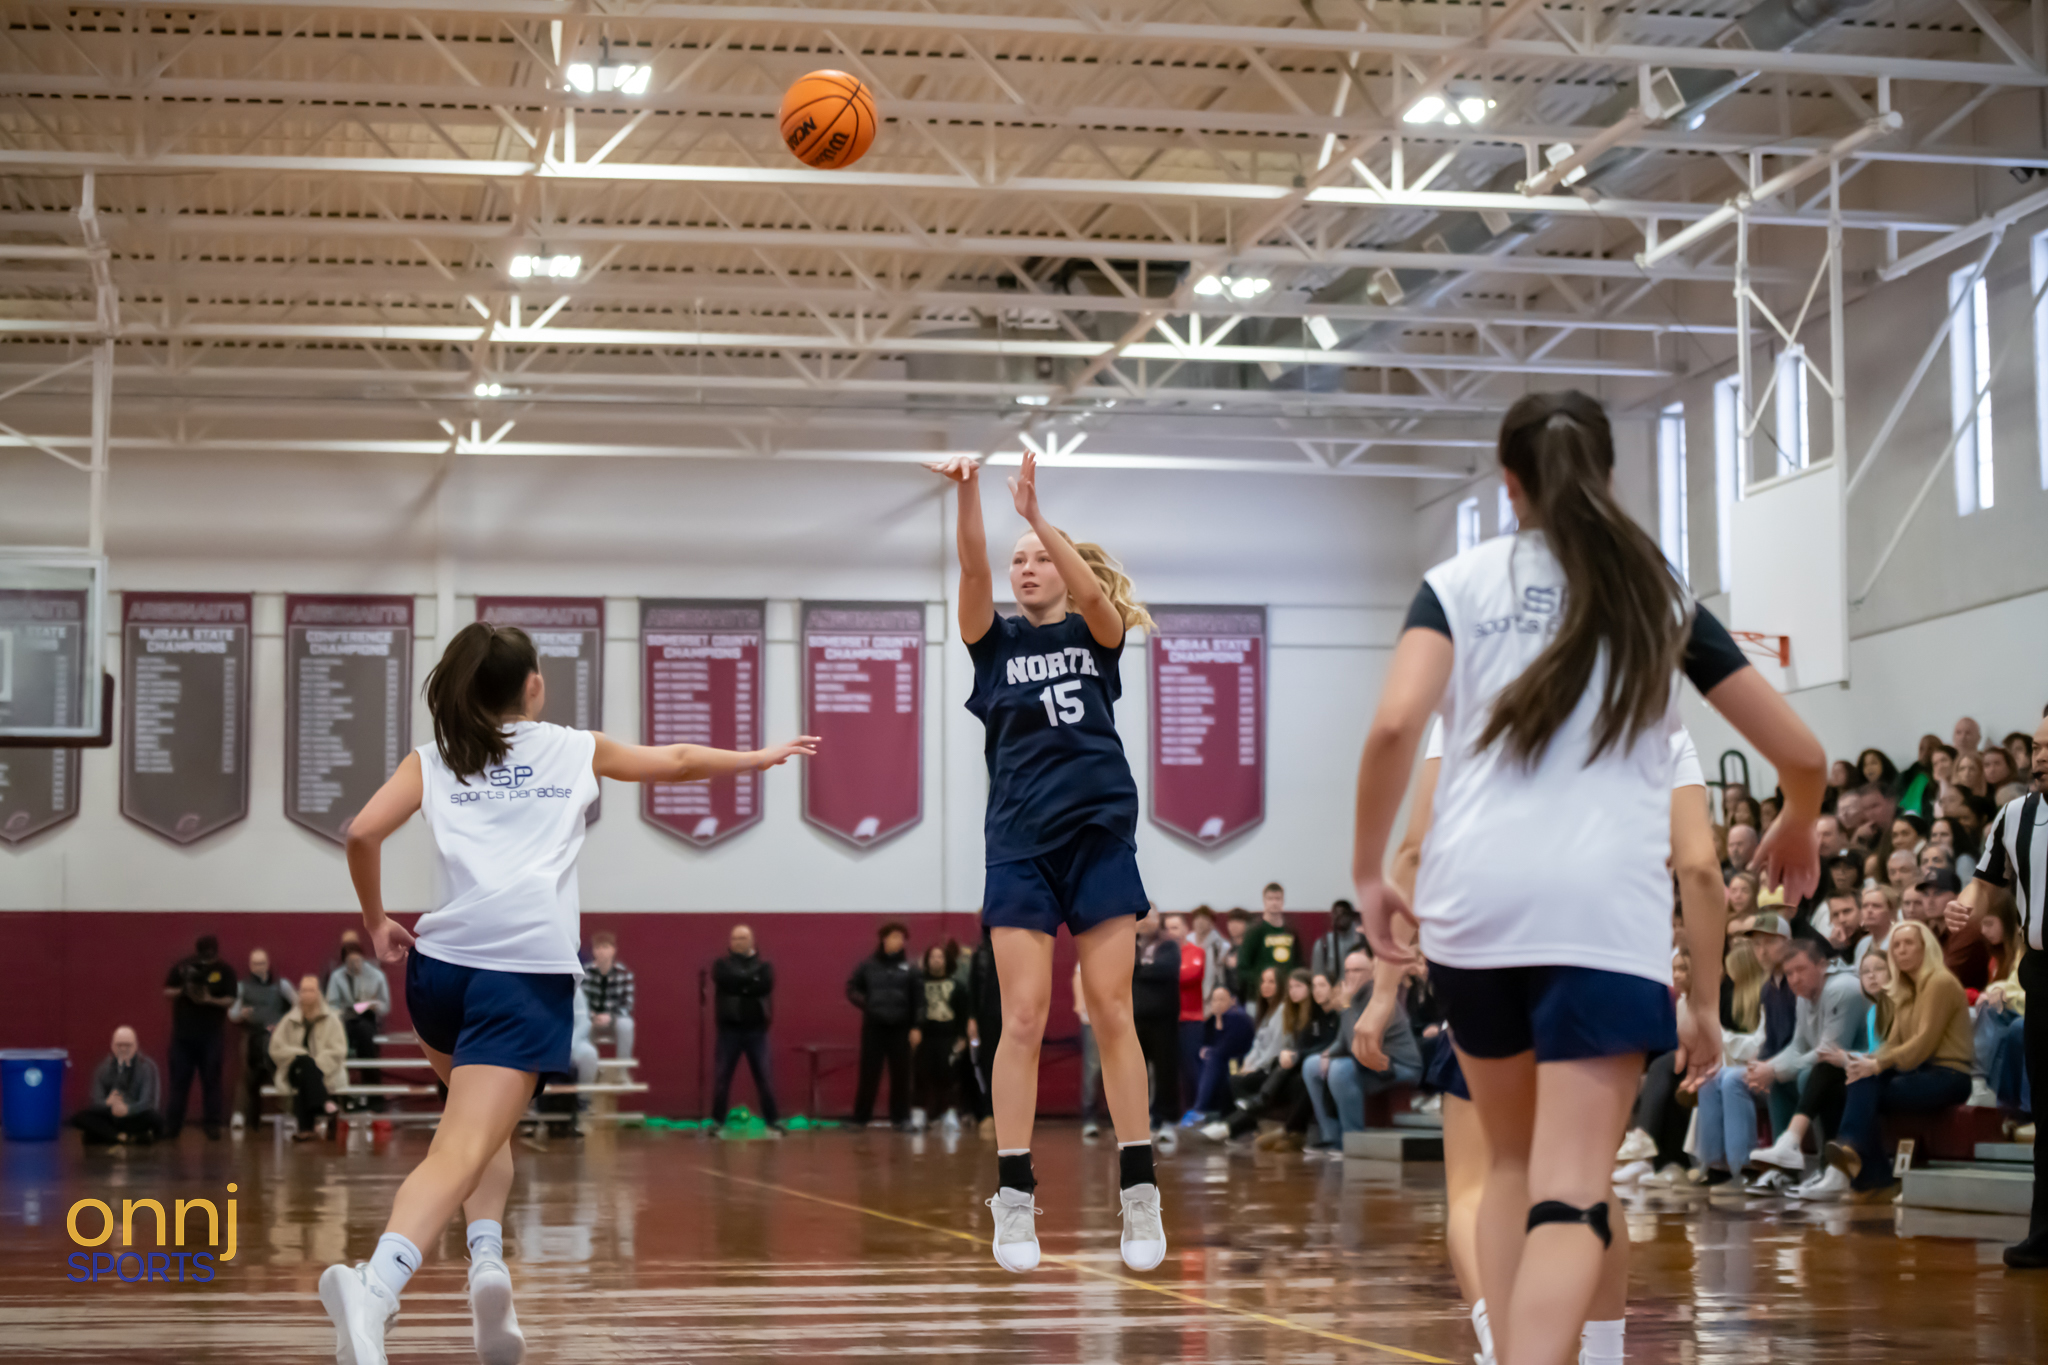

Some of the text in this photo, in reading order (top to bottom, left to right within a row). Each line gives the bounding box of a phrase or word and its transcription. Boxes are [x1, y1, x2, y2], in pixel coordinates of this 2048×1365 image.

[193, 629, 235, 642] STATE
[305, 631, 393, 644] CONFERENCE
[531, 633, 582, 645] ERENCE
[647, 635, 758, 648] SOMERSET COUNTY
[808, 635, 918, 649] SOMERSET COUNTY
[146, 641, 227, 654] CHAMPIONS
[309, 643, 390, 656] CHAMPIONS
[539, 645, 579, 658] PIONS
[1212, 639, 1251, 652] STATE
[663, 646, 741, 659] CHAMPIONS
[824, 647, 902, 661] CHAMPIONS
[1168, 651, 1244, 664] CHAMPIONS
[1006, 647, 1100, 685] NORTH
[1039, 680, 1085, 727] 15
[489, 765, 533, 787] SP
[450, 784, 573, 806] sports paradise
